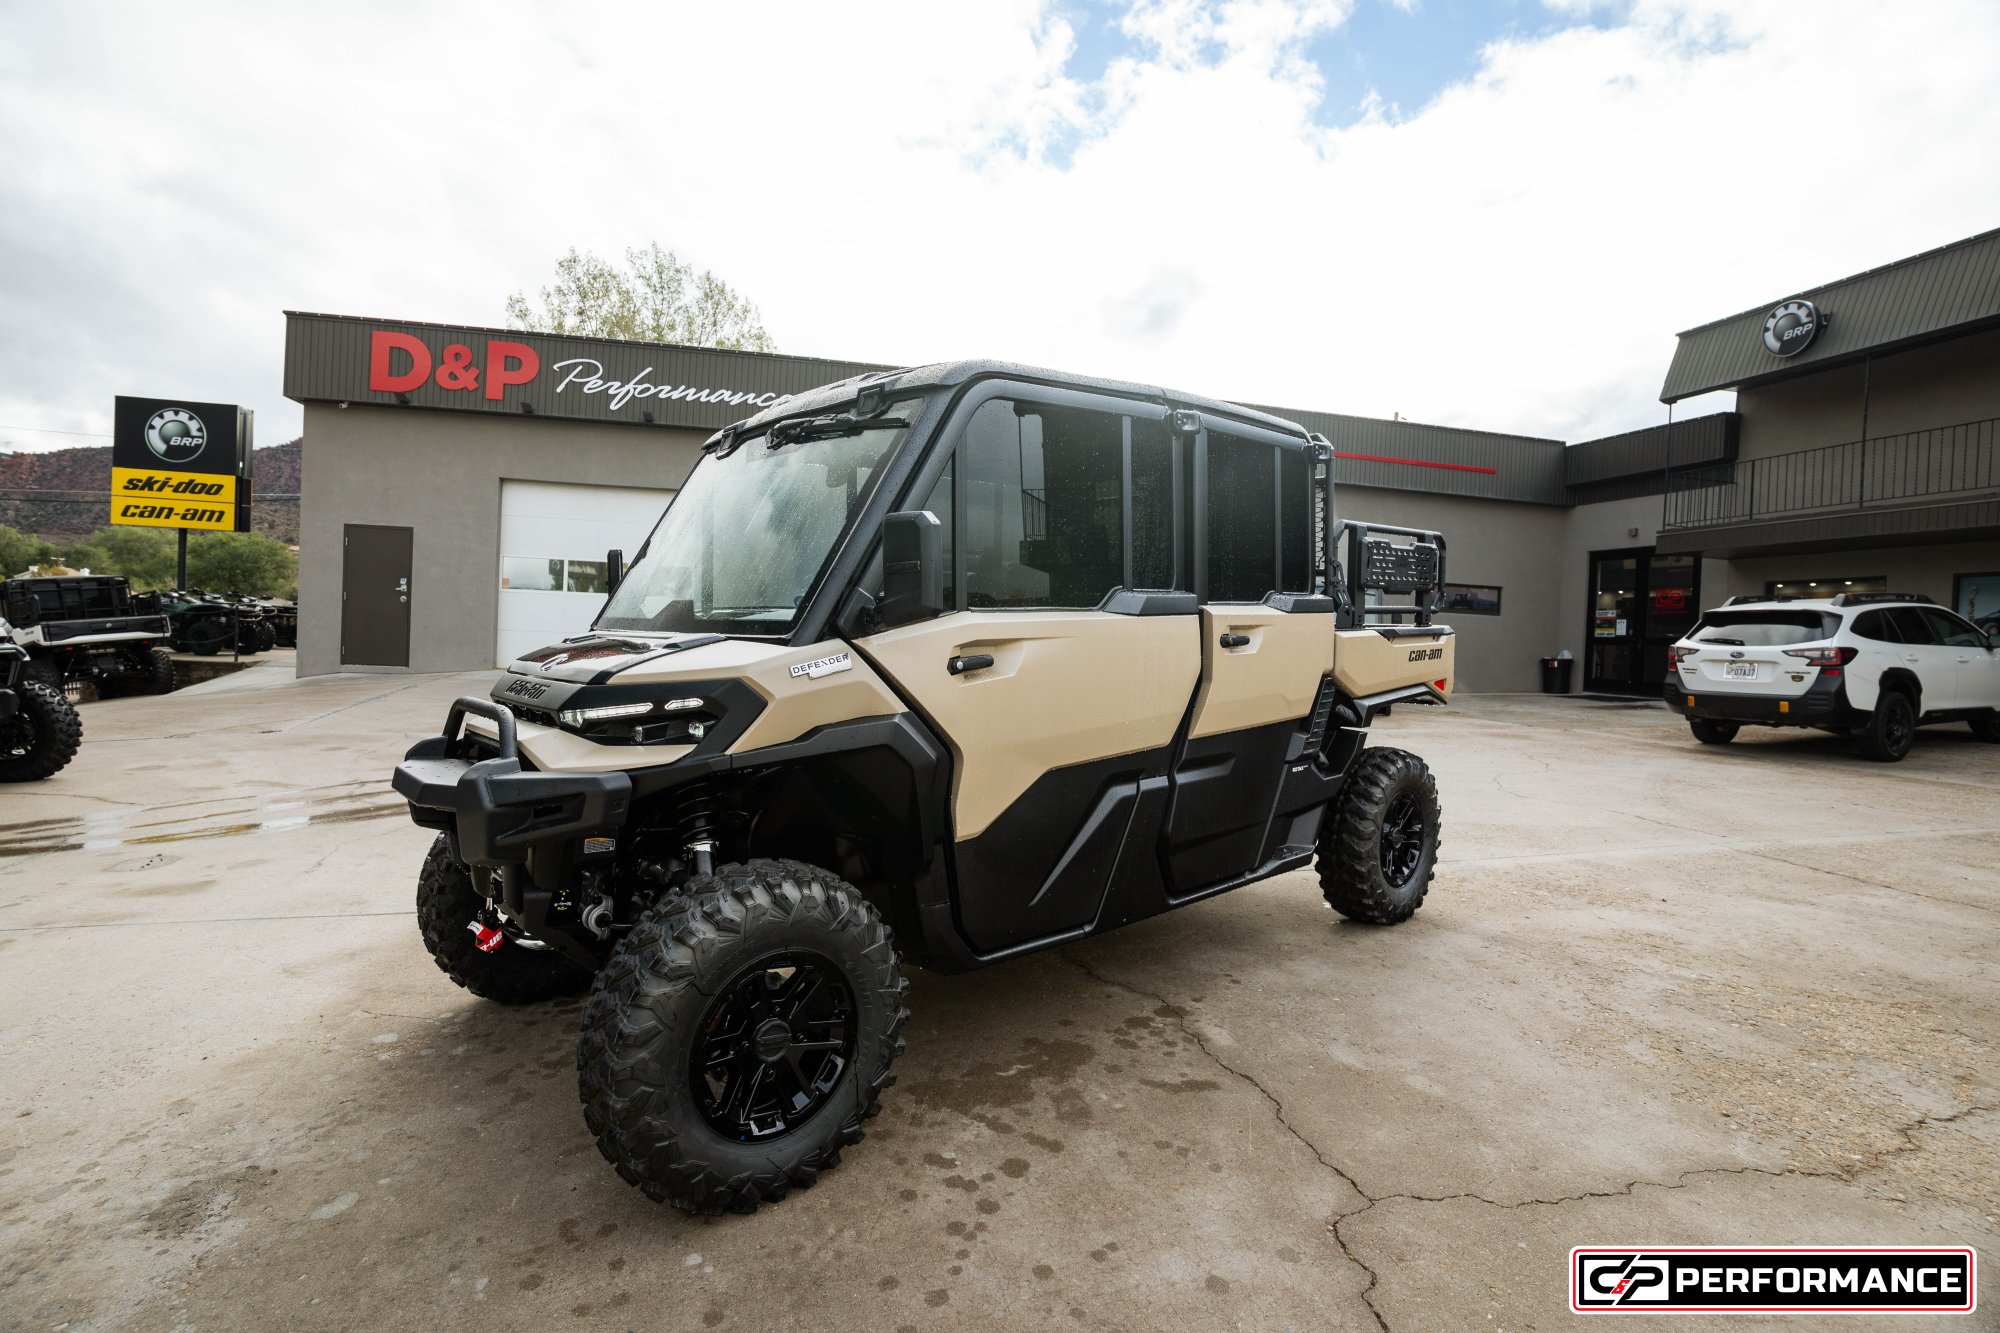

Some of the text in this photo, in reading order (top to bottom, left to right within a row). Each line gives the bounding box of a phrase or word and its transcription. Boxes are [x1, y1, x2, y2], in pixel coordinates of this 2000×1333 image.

[1783, 323, 1813, 340] BRP
[369, 330, 541, 400] D&P
[169, 436, 204, 447] BRP
[122, 476, 225, 496] ski-doo
[120, 504, 226, 523] can-am
[792, 653, 850, 674] DEFENDER
[1408, 648, 1443, 662] can-am
